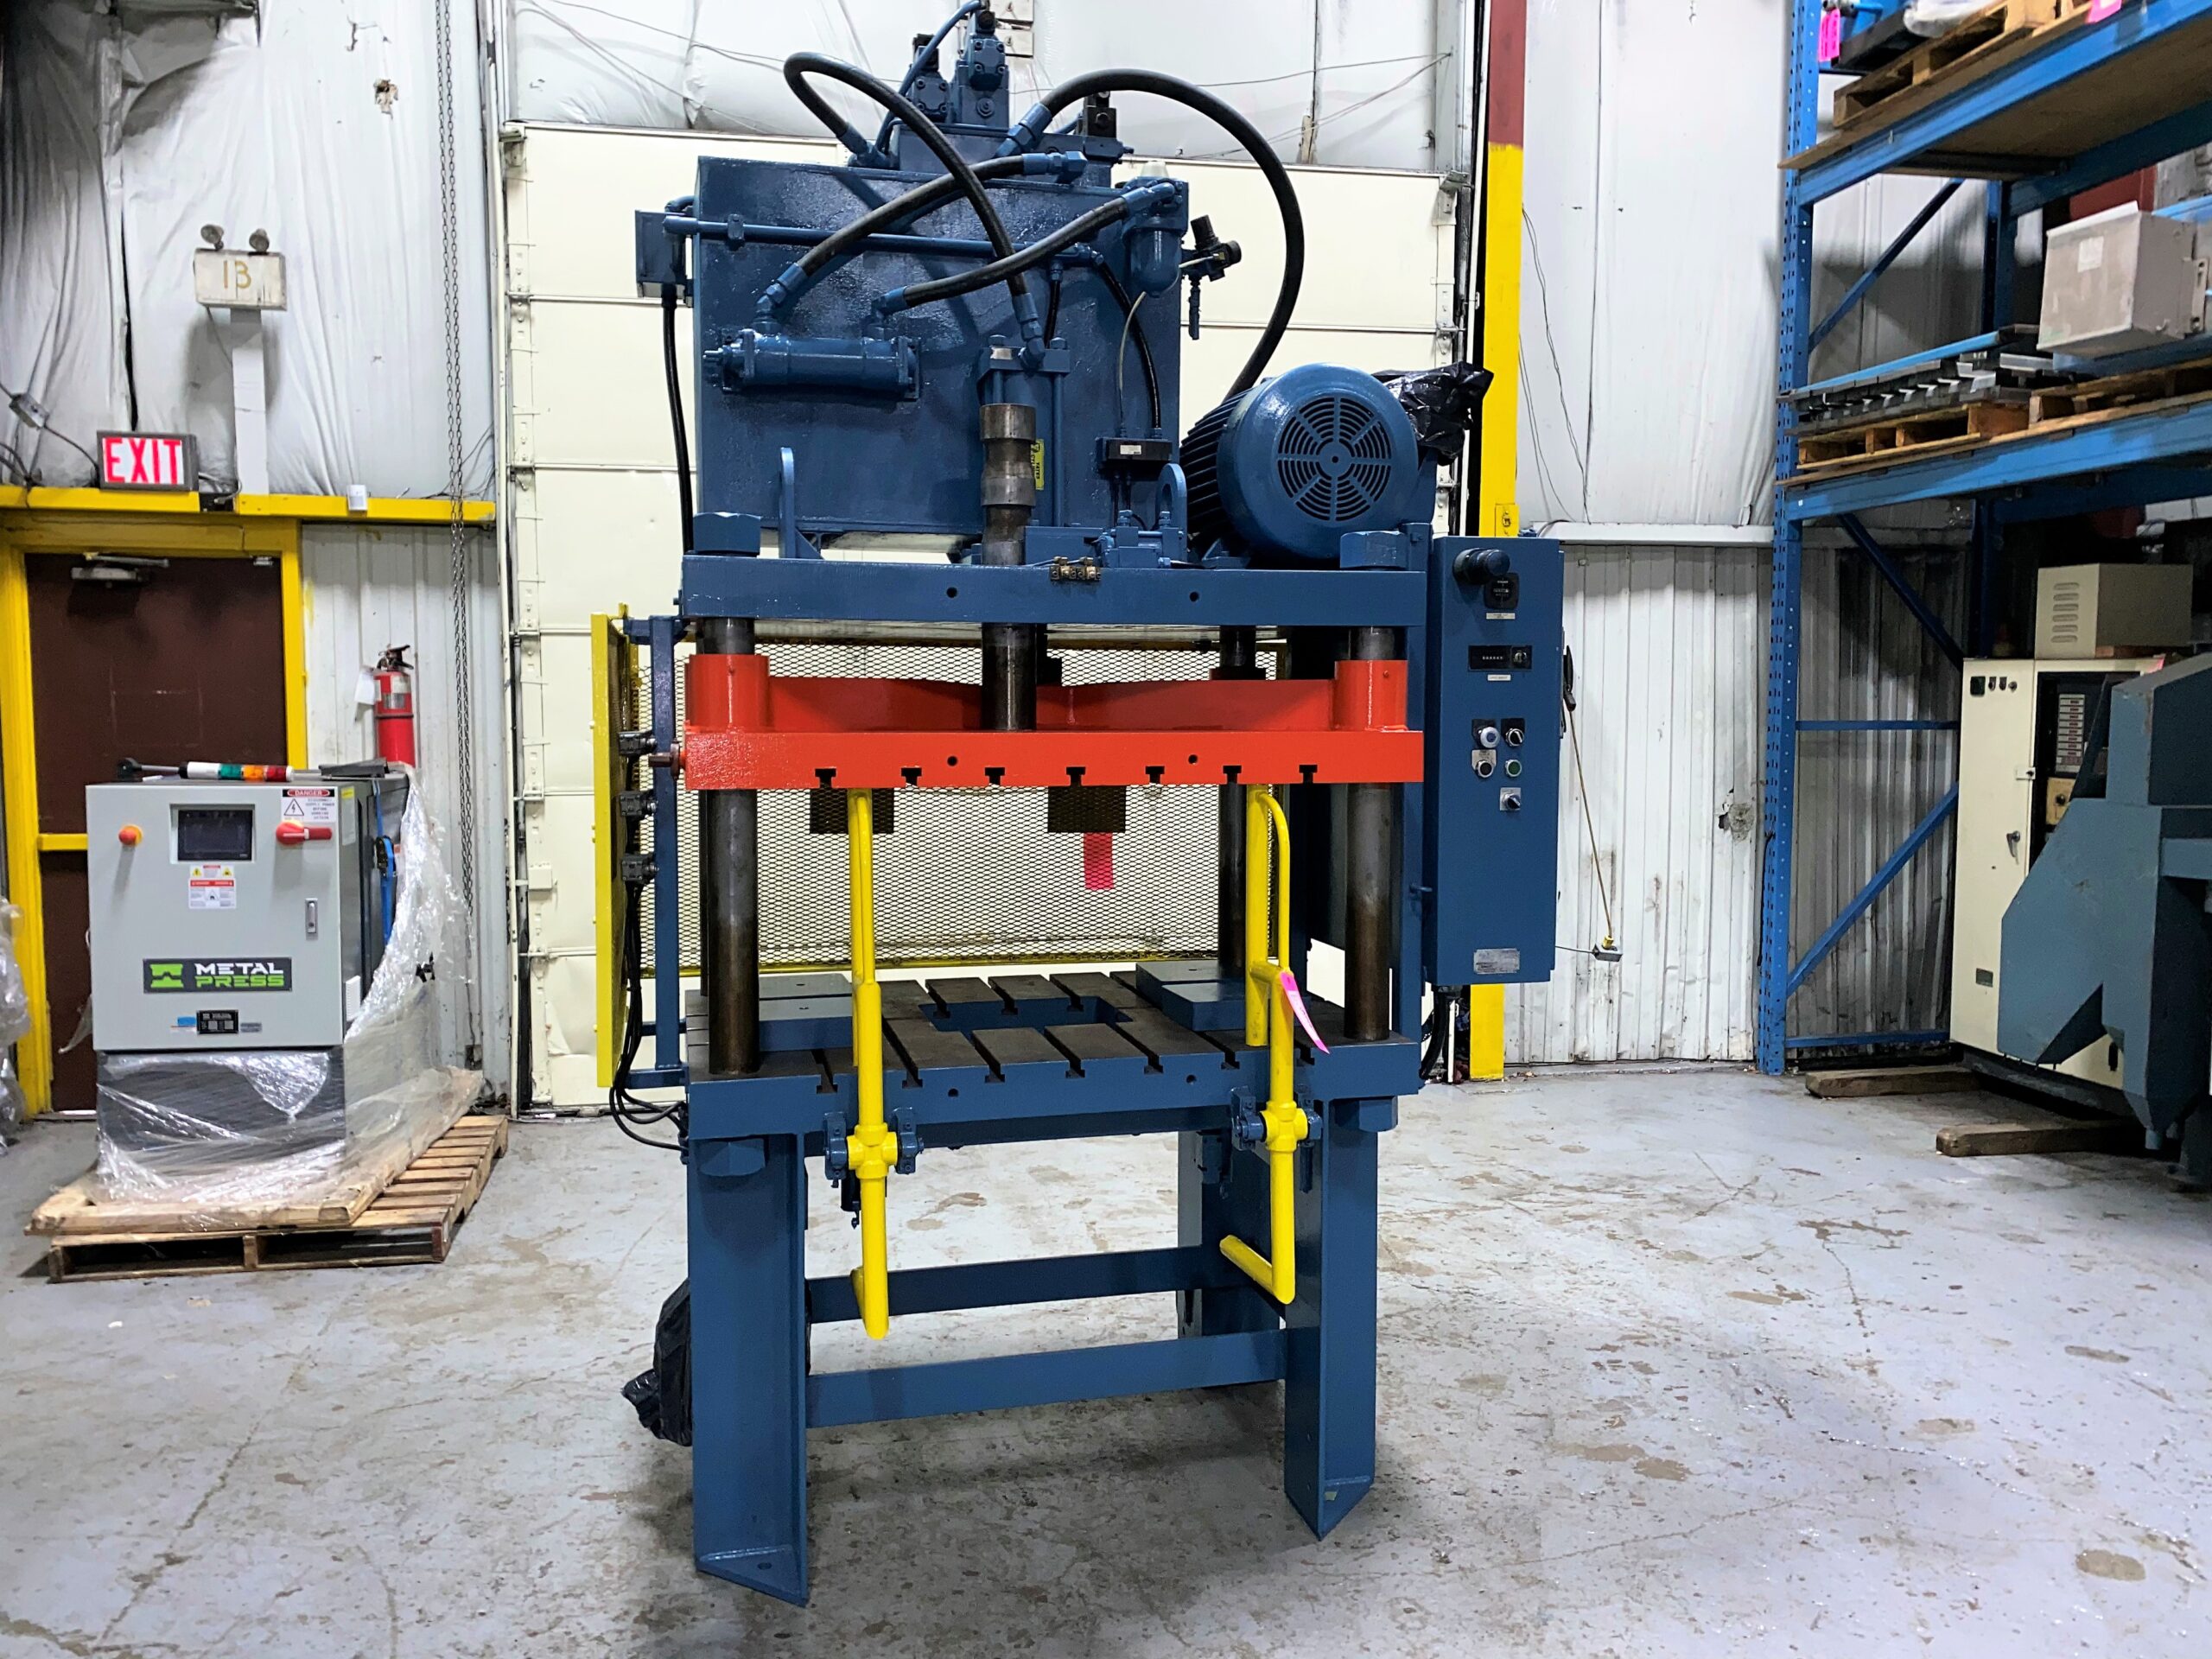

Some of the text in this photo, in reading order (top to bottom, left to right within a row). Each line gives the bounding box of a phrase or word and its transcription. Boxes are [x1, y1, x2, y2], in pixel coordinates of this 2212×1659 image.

[105, 437, 181, 485] EXIT
[194, 962, 284, 975] METAL
[194, 975, 284, 988] PRESS
